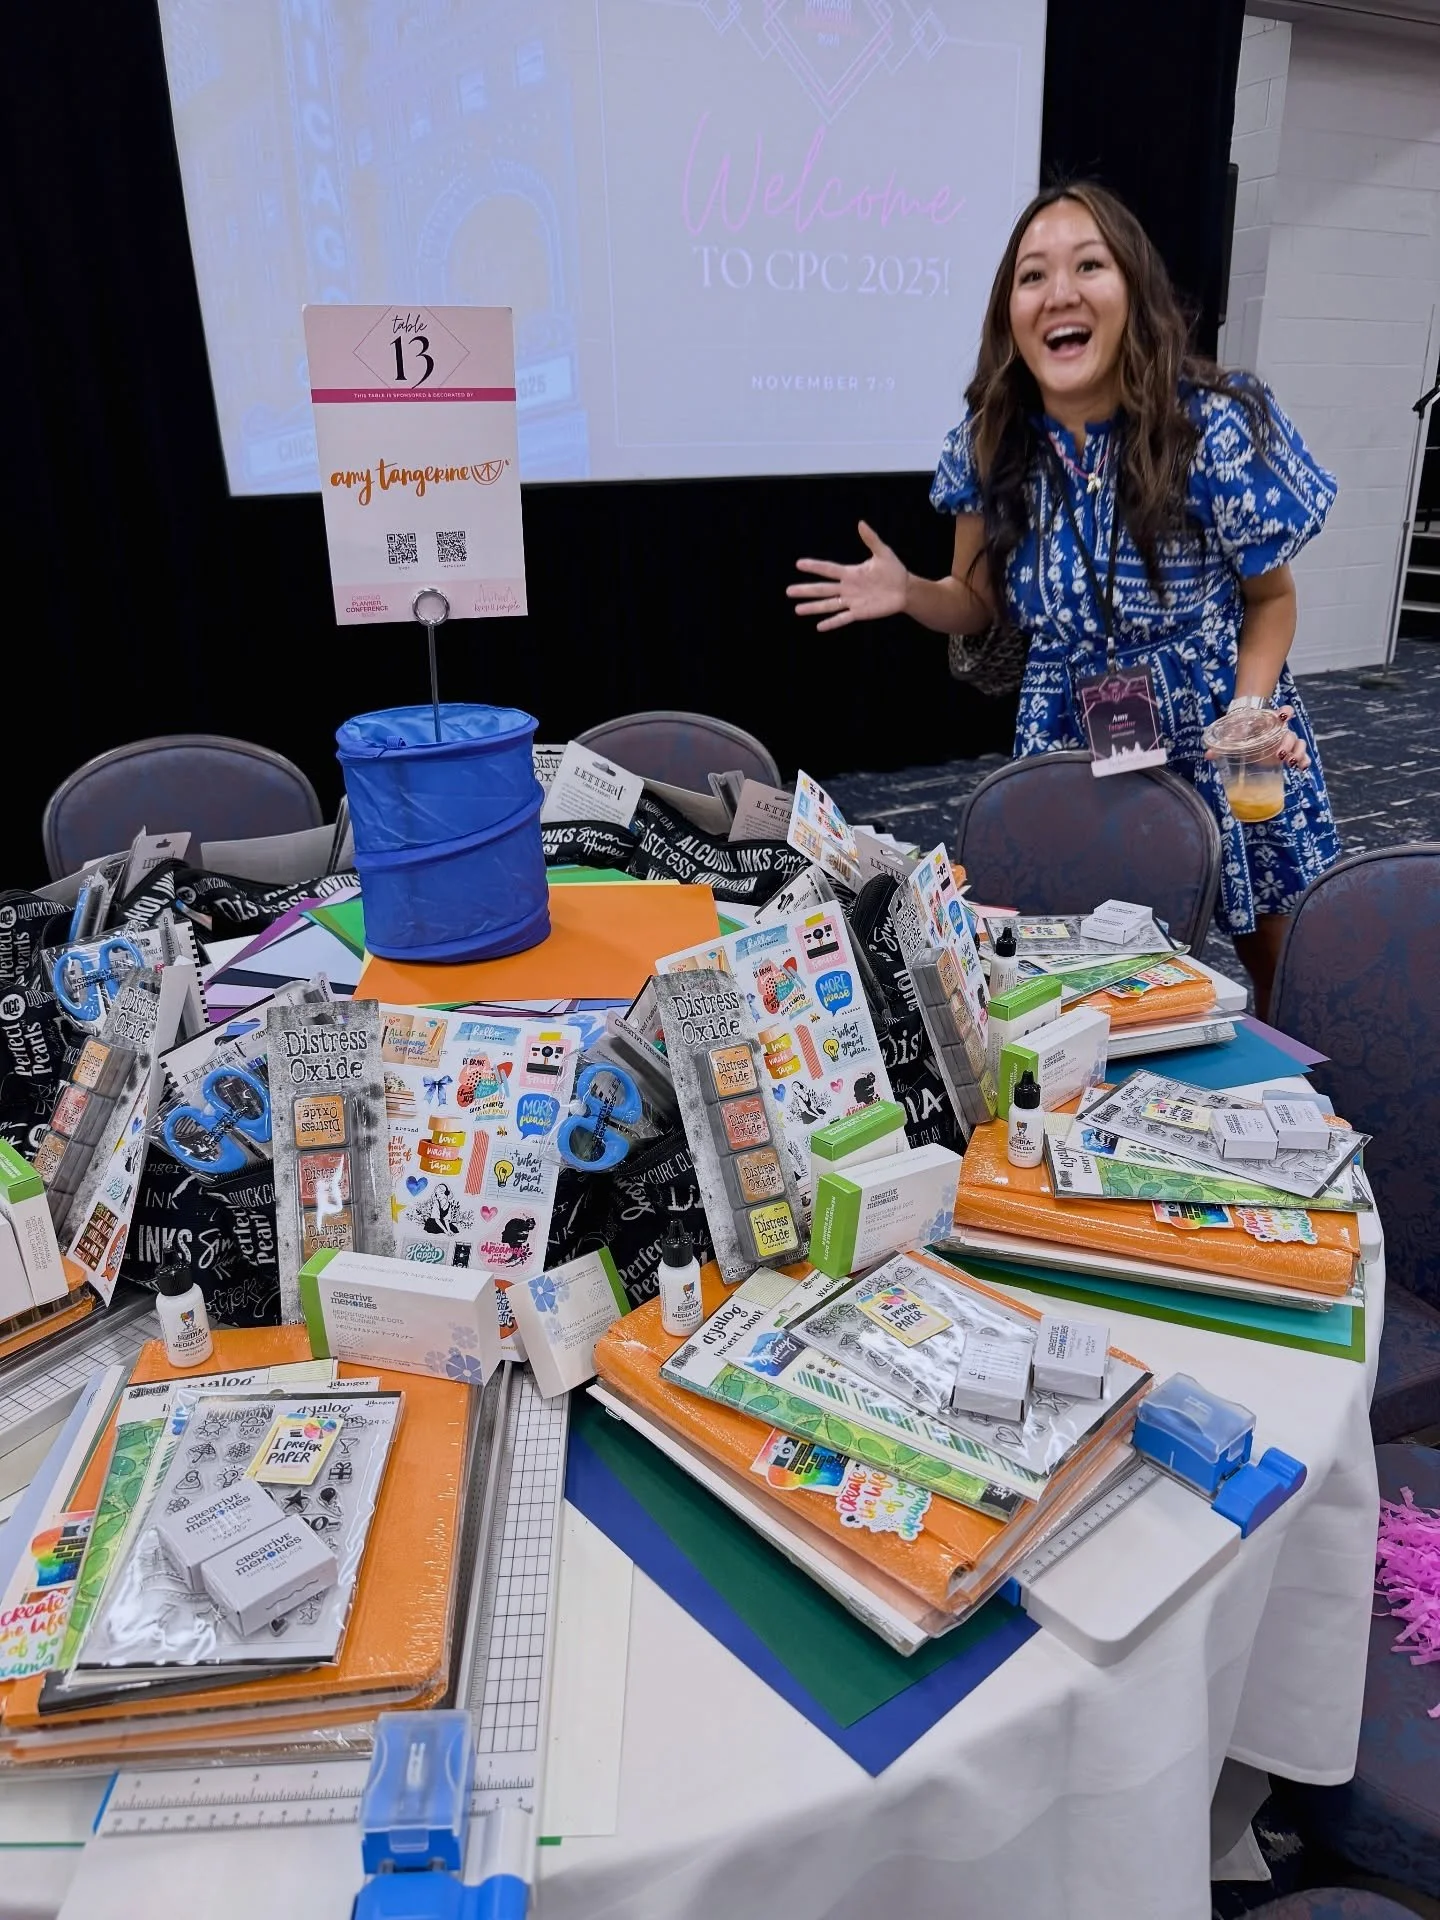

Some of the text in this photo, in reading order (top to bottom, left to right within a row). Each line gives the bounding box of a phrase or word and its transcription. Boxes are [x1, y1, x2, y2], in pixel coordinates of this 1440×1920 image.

[682, 111, 967, 235] Welcome
[692, 245, 952, 297] TO CPC 2025!
[392, 313, 428, 334] table
[390, 335, 434, 389] 13
[751, 374, 858, 391] NOVEMBER
[331, 458, 471, 506] amy tangerine
[639, 822, 698, 880] istress
[675, 834, 737, 873] ALCOHOL
[737, 848, 773, 873] INKS
[820, 974, 849, 995] MORE
[672, 991, 740, 1021] Distress
[823, 989, 851, 1007] please
[115, 1012, 151, 1045] Oxide
[388, 1028, 403, 1037] ALL
[682, 1016, 741, 1045] Oxide
[837, 1021, 859, 1039] what
[2, 1022, 34, 1078] perfect
[24, 1021, 52, 1076] pearls
[284, 1027, 369, 1057] Distress
[841, 1035, 864, 1056] great
[290, 1056, 363, 1084] Oxide
[717, 1058, 749, 1074] Distress
[720, 1070, 750, 1085] Oxide
[303, 1106, 338, 1120] Oxide
[729, 1110, 762, 1127] Distress
[301, 1118, 341, 1133] Distress
[734, 1123, 762, 1138] Oxide
[438, 1133, 458, 1145] love
[429, 1160, 452, 1172] tape
[743, 1162, 776, 1179] Distress
[513, 1171, 543, 1188] great
[519, 1182, 544, 1195] idea.
[748, 1174, 777, 1191] Oxide
[755, 1215, 789, 1233] Distress
[139, 1224, 193, 1264] INKS
[760, 1228, 790, 1245] Oxide
[617, 1234, 664, 1289] Perfec
[702, 1303, 742, 1346] dyalog
[894, 1310, 928, 1332] PAPER
[714, 1308, 765, 1359] insert book
[296, 1401, 353, 1421] dyalog
[273, 1437, 283, 1450] I
[267, 1451, 311, 1465] PAPER
[0, 1595, 65, 1626] create
[30, 1610, 69, 1638] life
[8, 1638, 29, 1660] of
